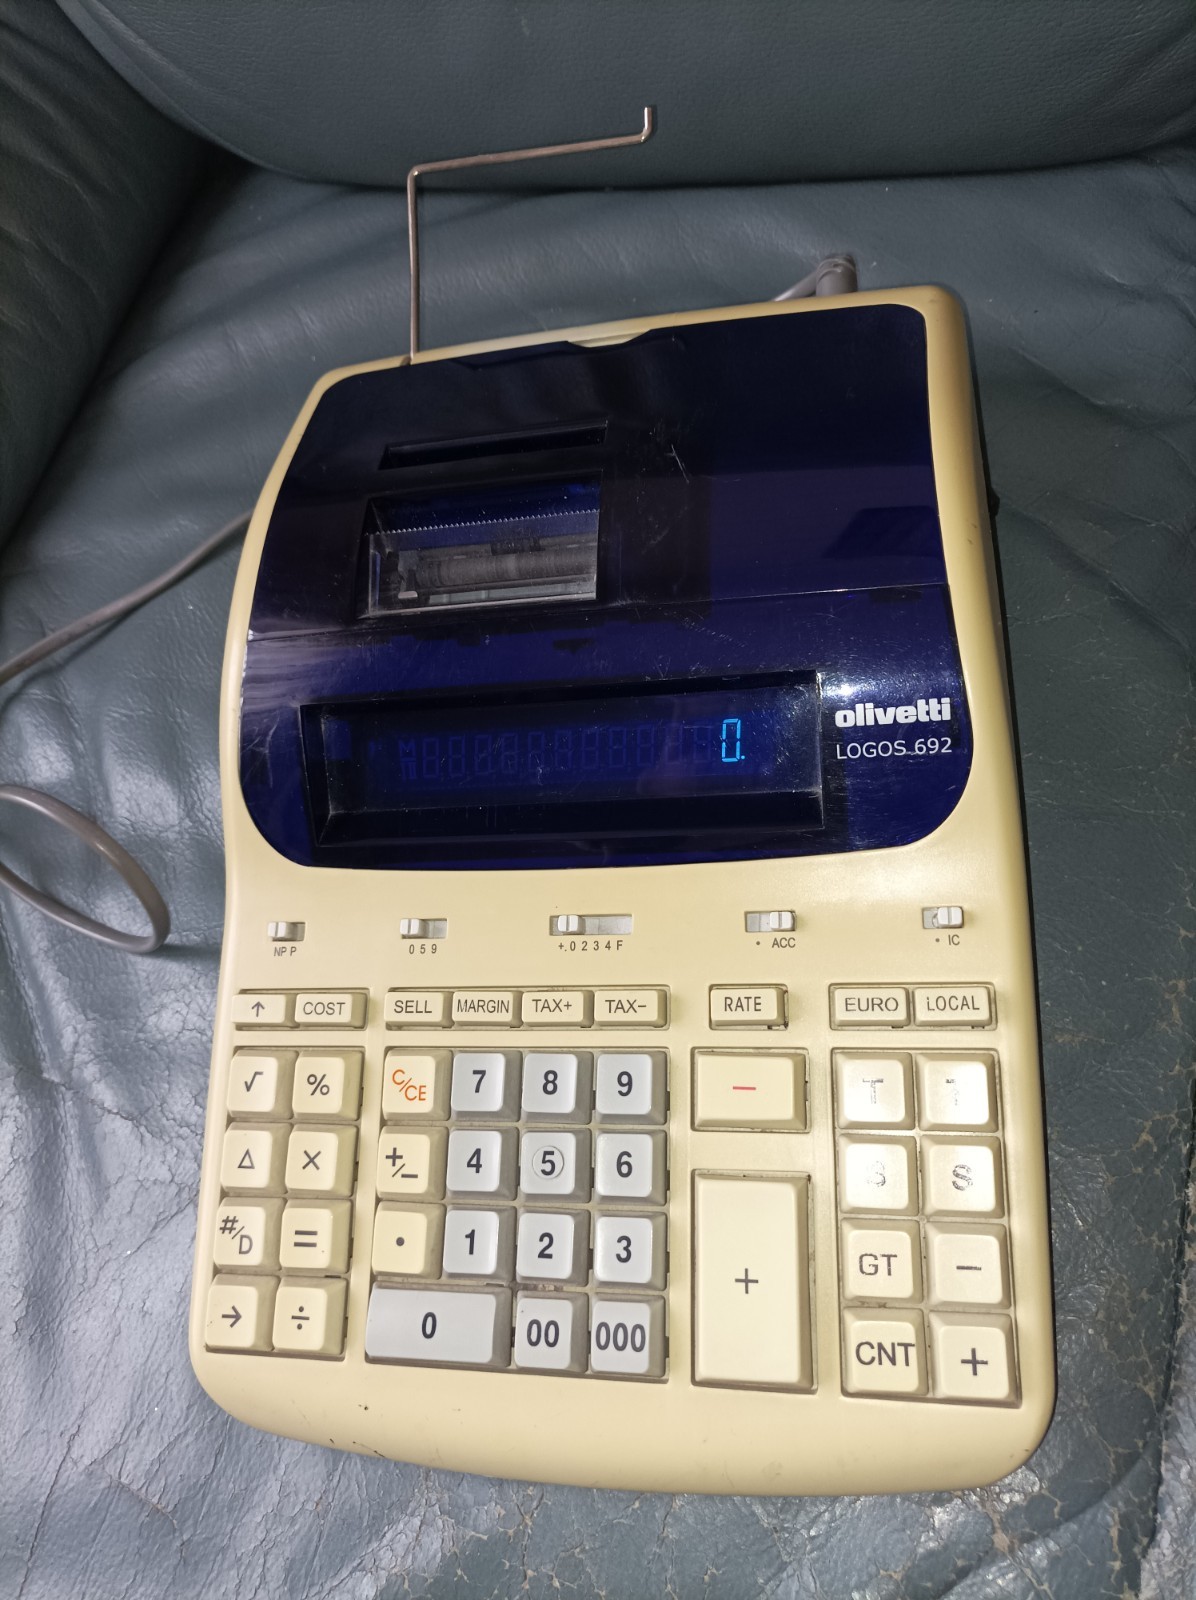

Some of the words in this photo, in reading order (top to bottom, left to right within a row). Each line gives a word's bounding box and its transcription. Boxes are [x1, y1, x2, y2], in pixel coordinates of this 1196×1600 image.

[835, 697, 951, 728] olivetti
[836, 740, 907, 760] LOGOS
[914, 737, 952, 756] 692
[771, 936, 796, 949] ACC
[947, 933, 961, 946] IC
[302, 1001, 346, 1016] COST
[393, 999, 433, 1014] SELL
[456, 998, 510, 1014] MARGIN
[724, 996, 762, 1013] RATE
[844, 996, 899, 1012] EURO
[926, 994, 981, 1012] LOCAL
[472, 1069, 487, 1094] 7
[542, 1069, 559, 1096] 8
[616, 1070, 633, 1097] 9
[466, 1147, 483, 1174] 4
[540, 1150, 556, 1177] 5
[616, 1150, 633, 1179] 6
[952, 1163, 974, 1191] S
[464, 1228, 476, 1256] 1
[537, 1231, 554, 1260] 2
[615, 1235, 632, 1264] 3
[858, 1252, 898, 1277] GT
[421, 1311, 438, 1340] 0
[526, 1318, 560, 1348] 00
[595, 1321, 647, 1353] 000
[855, 1341, 916, 1367] CNT
